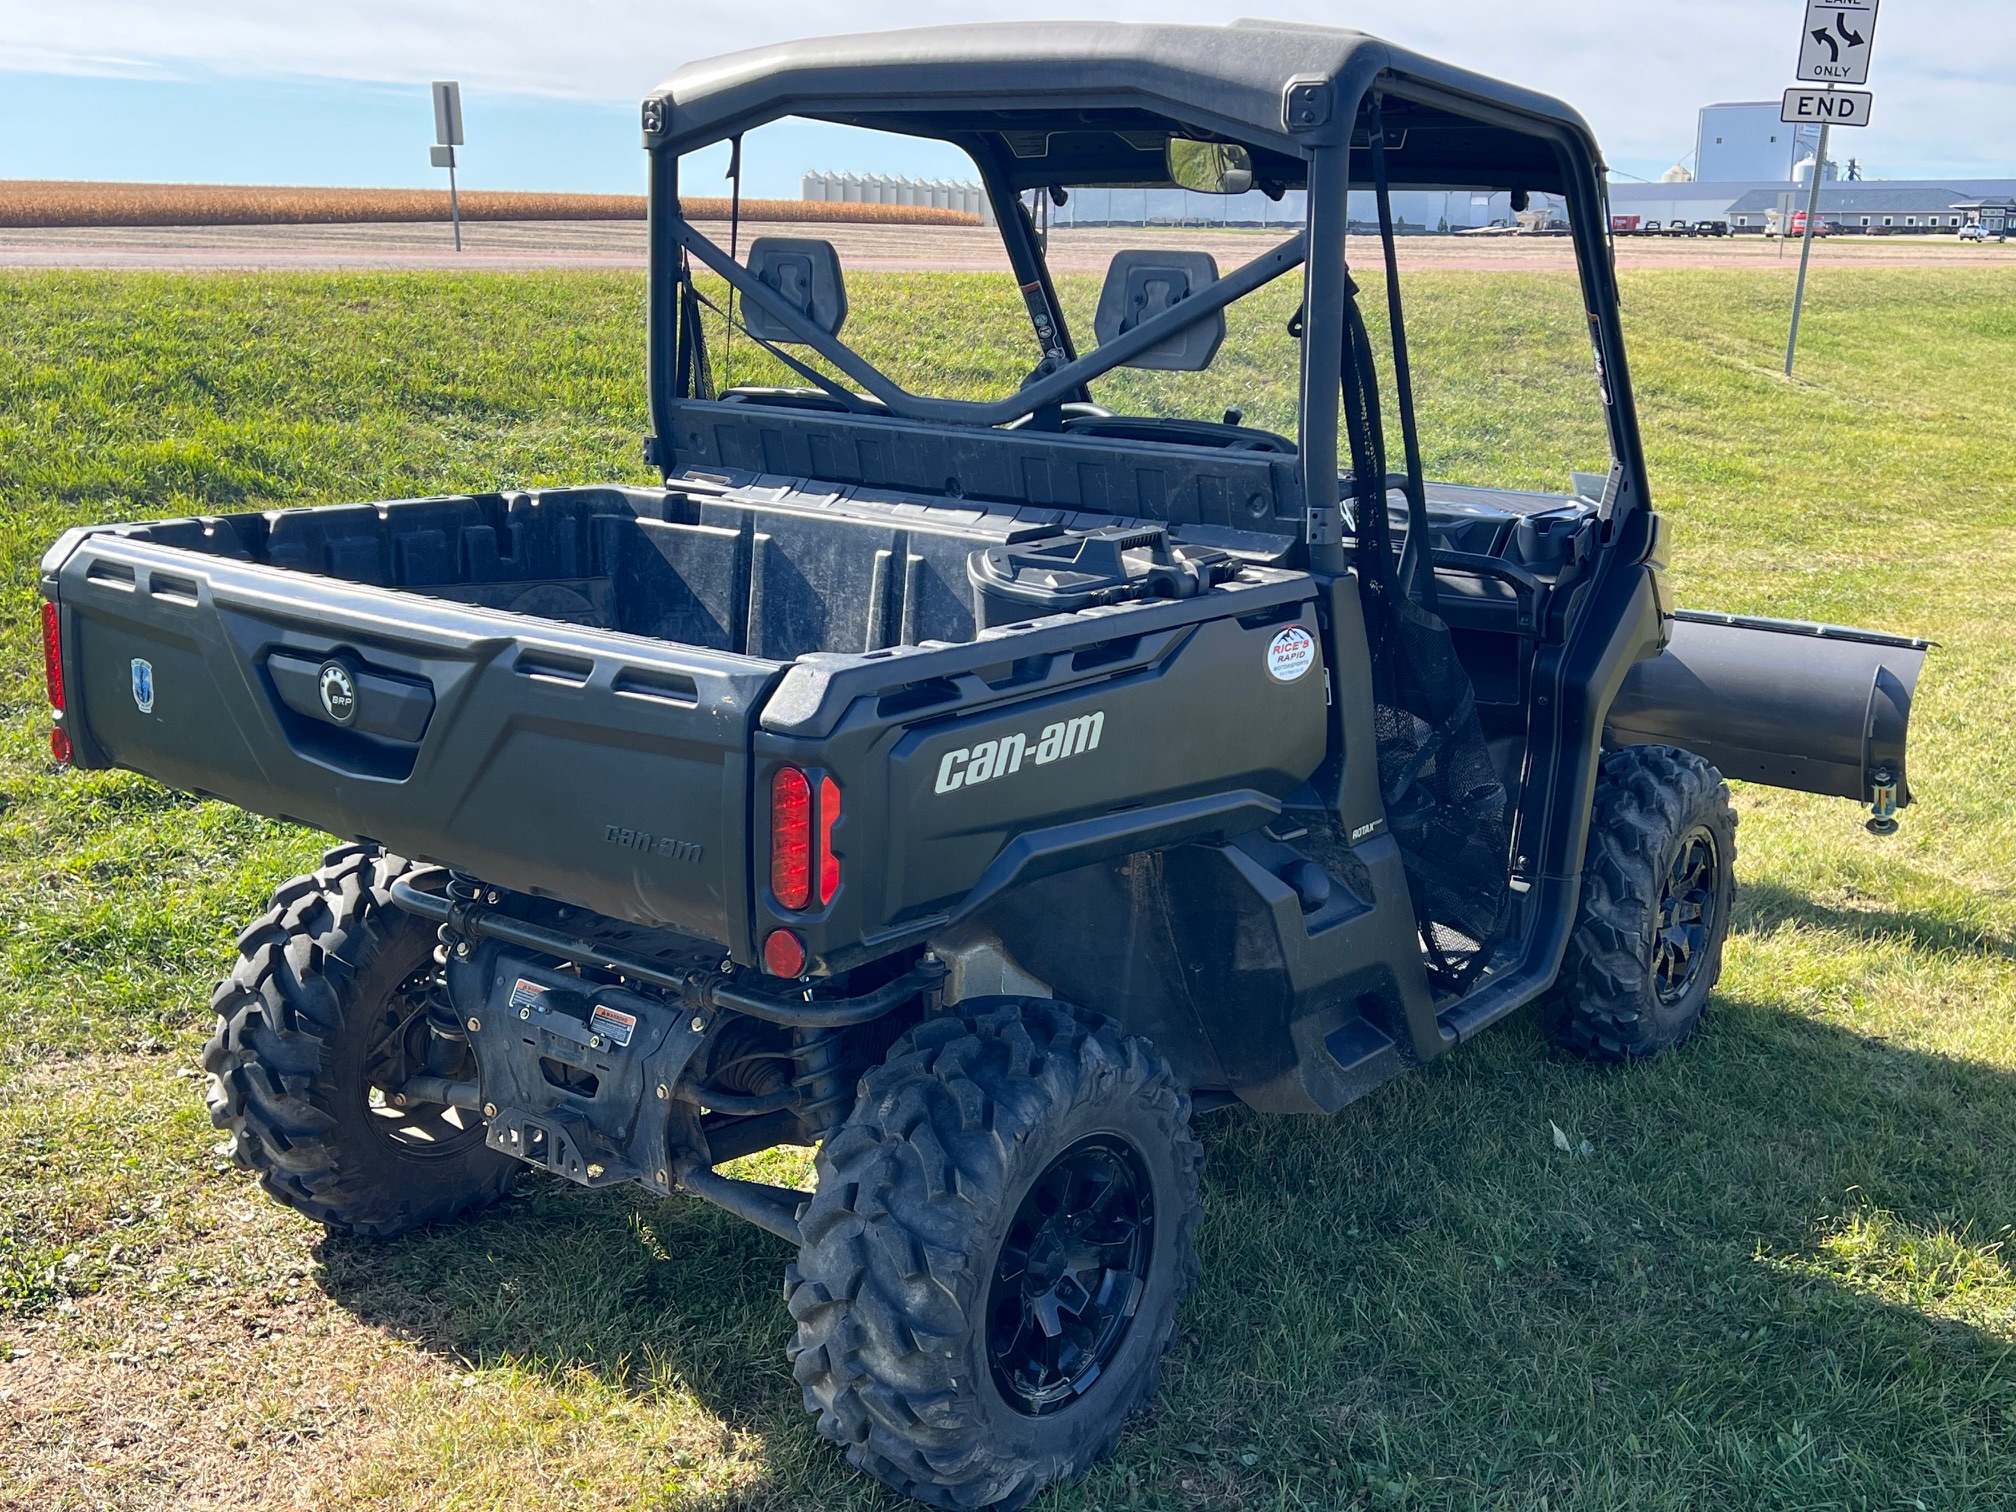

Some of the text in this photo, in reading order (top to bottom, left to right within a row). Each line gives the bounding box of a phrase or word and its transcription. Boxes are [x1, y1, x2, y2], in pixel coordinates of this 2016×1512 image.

[1813, 65, 1851, 77] ONLY
[1797, 96, 1855, 117] END
[1272, 639, 1310, 655] RICE'S
[1277, 651, 1306, 663] RAPID
[1273, 660, 1310, 672] MOTORSPORTS
[332, 695, 352, 706] BRP
[934, 710, 1105, 794] can-am
[1352, 823, 1375, 840] ROTAX
